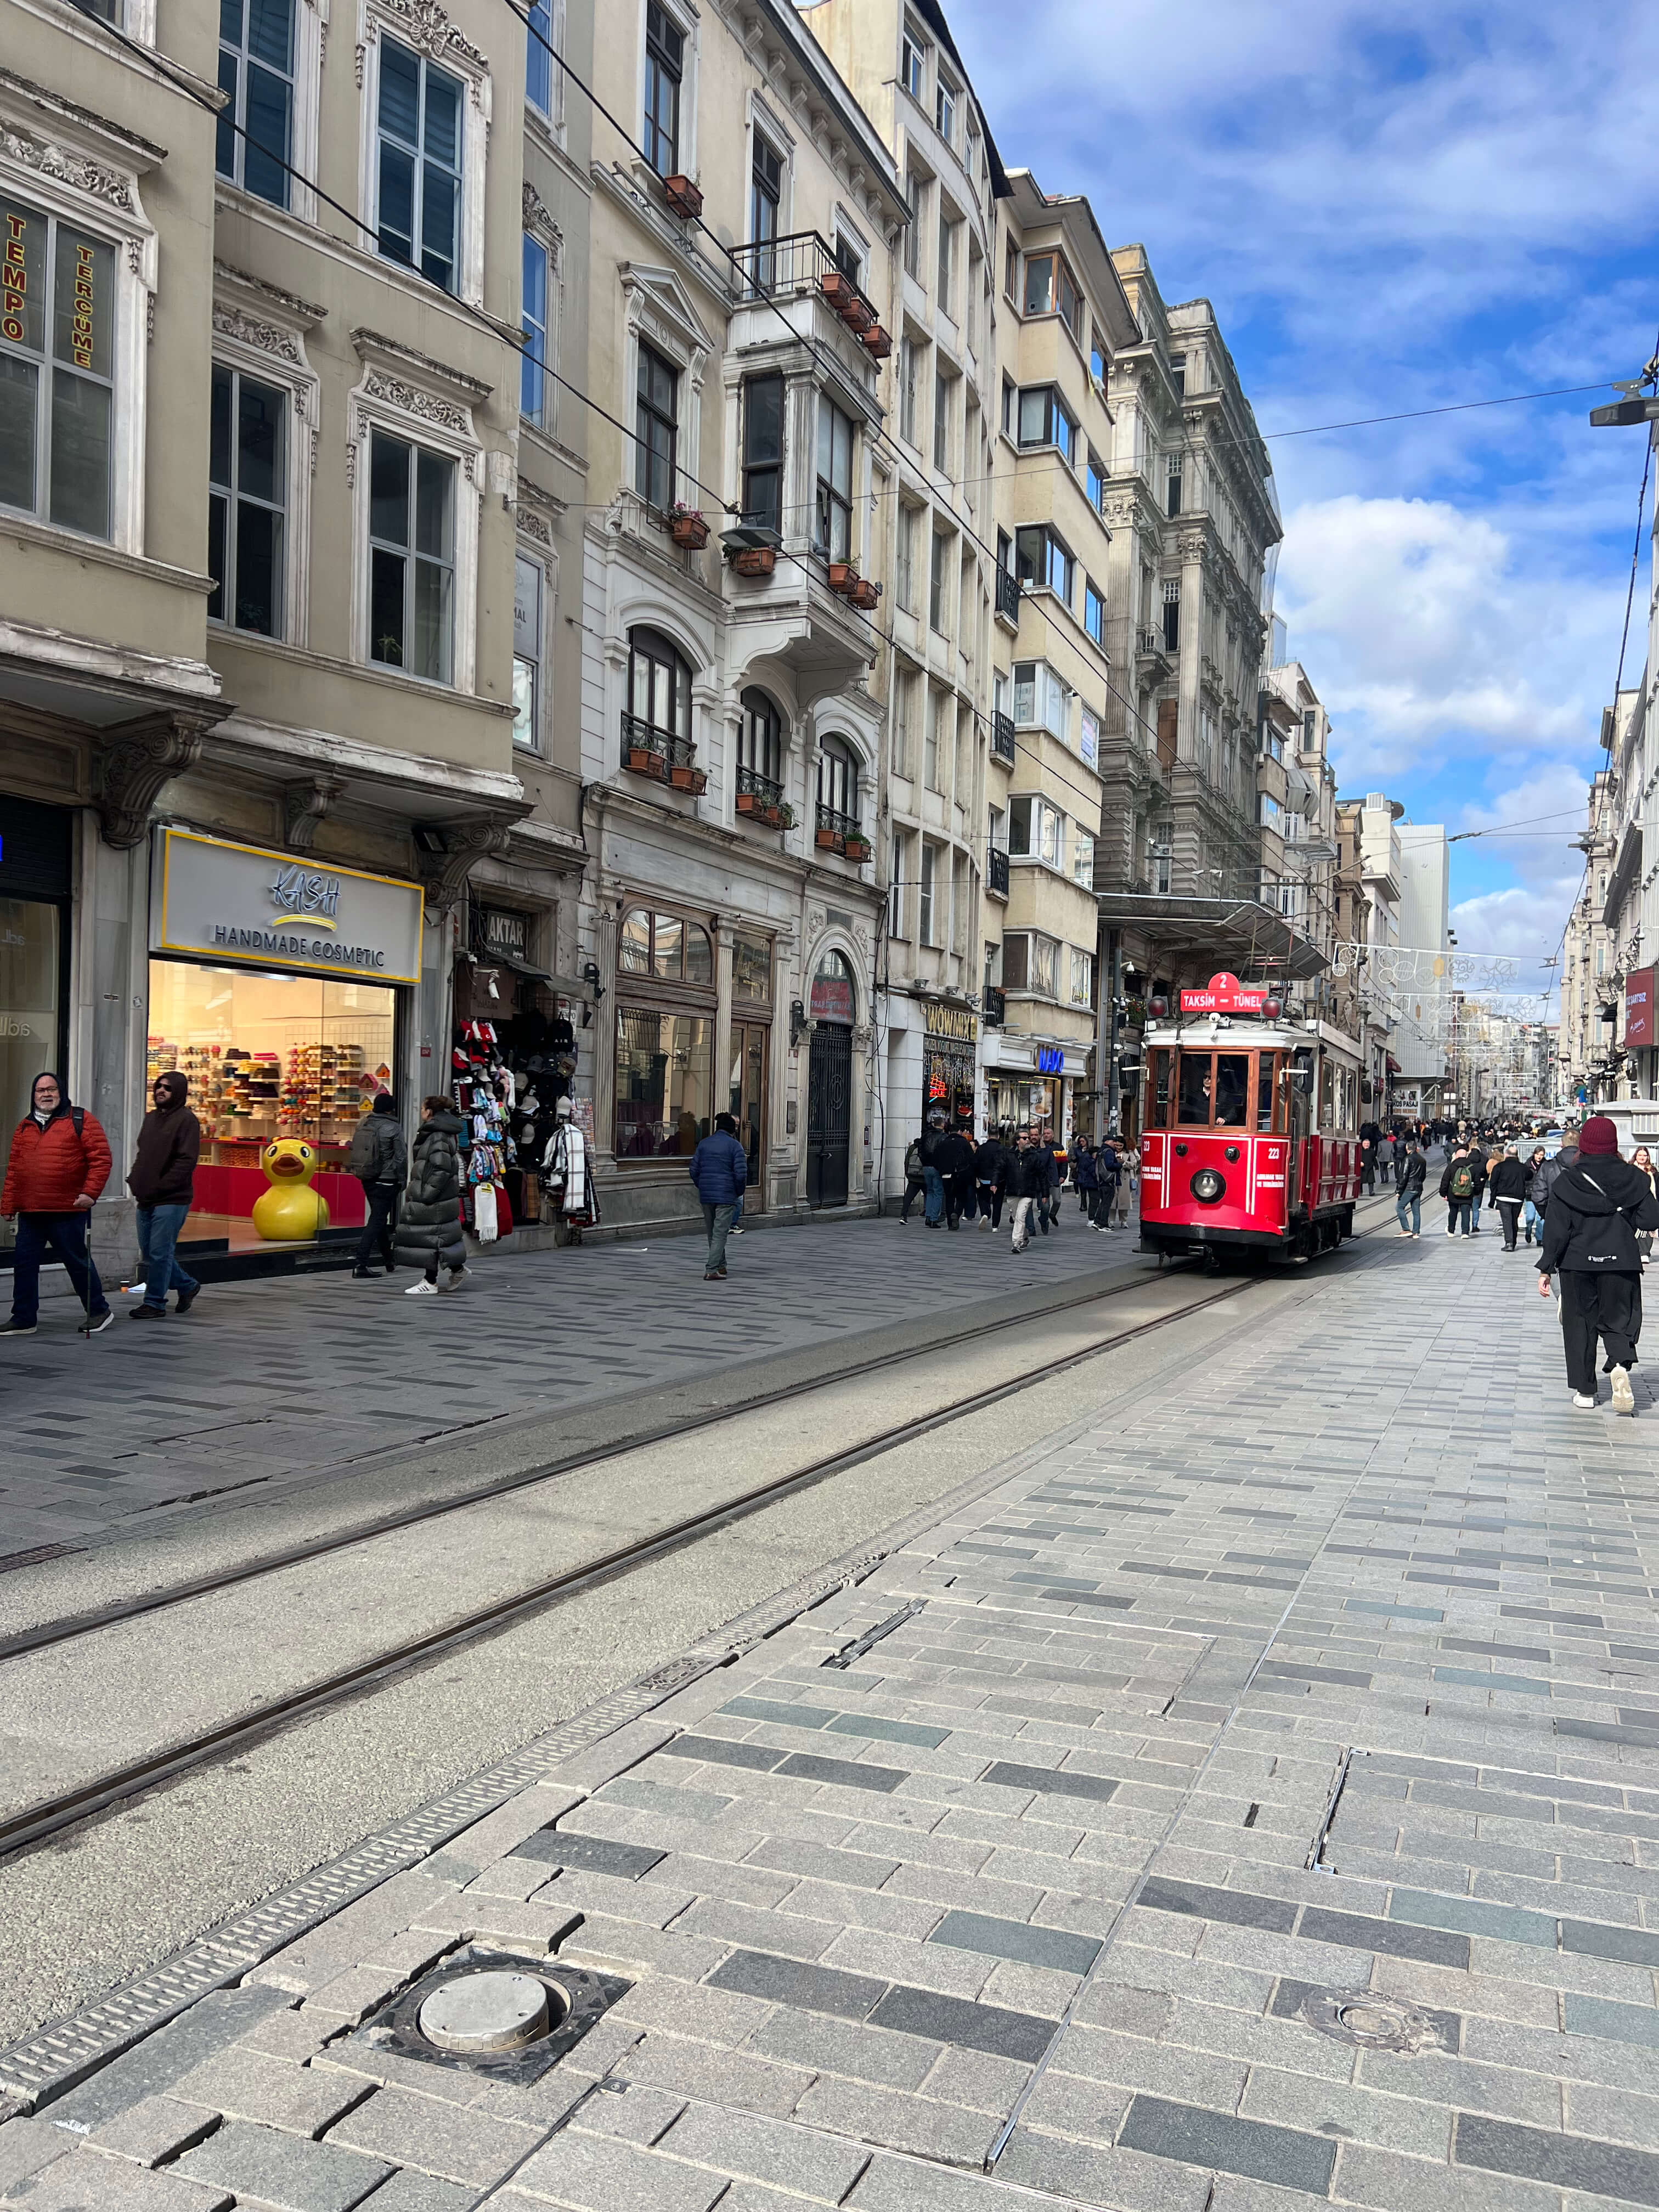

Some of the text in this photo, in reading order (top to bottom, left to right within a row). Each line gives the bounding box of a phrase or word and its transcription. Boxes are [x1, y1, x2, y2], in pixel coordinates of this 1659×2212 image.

[2, 213, 27, 341] TEMPO
[72, 244, 94, 369] TERCÜME
[272, 864, 342, 917] KASH
[215, 924, 385, 967] HANDMADE COSMETIC
[488, 916, 523, 946] AKTAR
[1219, 974, 1227, 988] 2
[1183, 992, 1215, 1007] TAKSİM
[1233, 992, 1261, 1007] TÜNEL
[1039, 1046, 1064, 1075] MADO
[1268, 1147, 1279, 1159] 223
